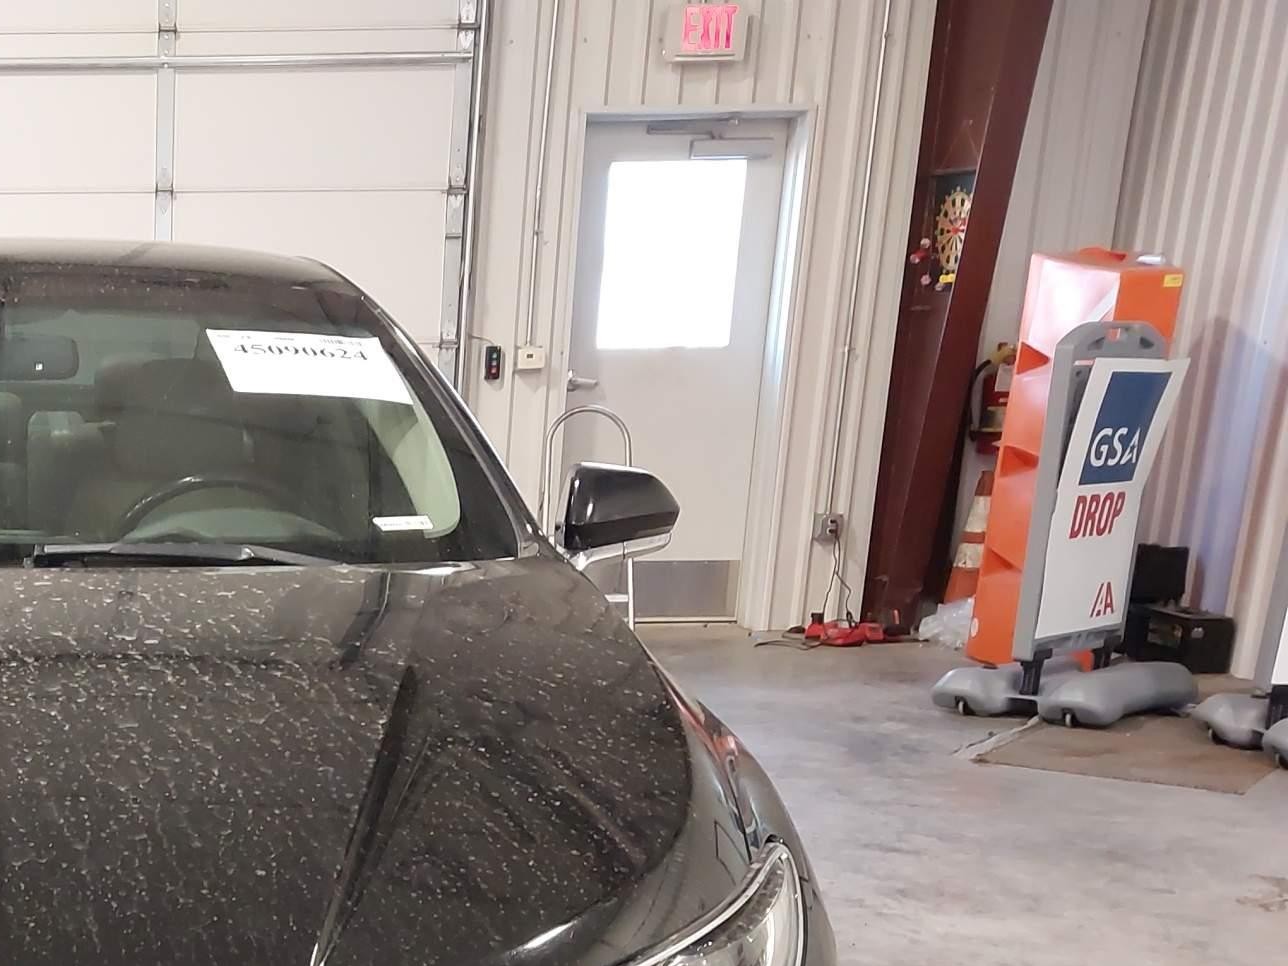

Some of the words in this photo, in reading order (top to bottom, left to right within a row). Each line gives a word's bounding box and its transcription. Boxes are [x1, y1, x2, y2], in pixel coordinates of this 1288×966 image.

[682, 5, 738, 50] EXIT
[1090, 426, 1142, 467] GSA
[1069, 491, 1126, 540] DROP
